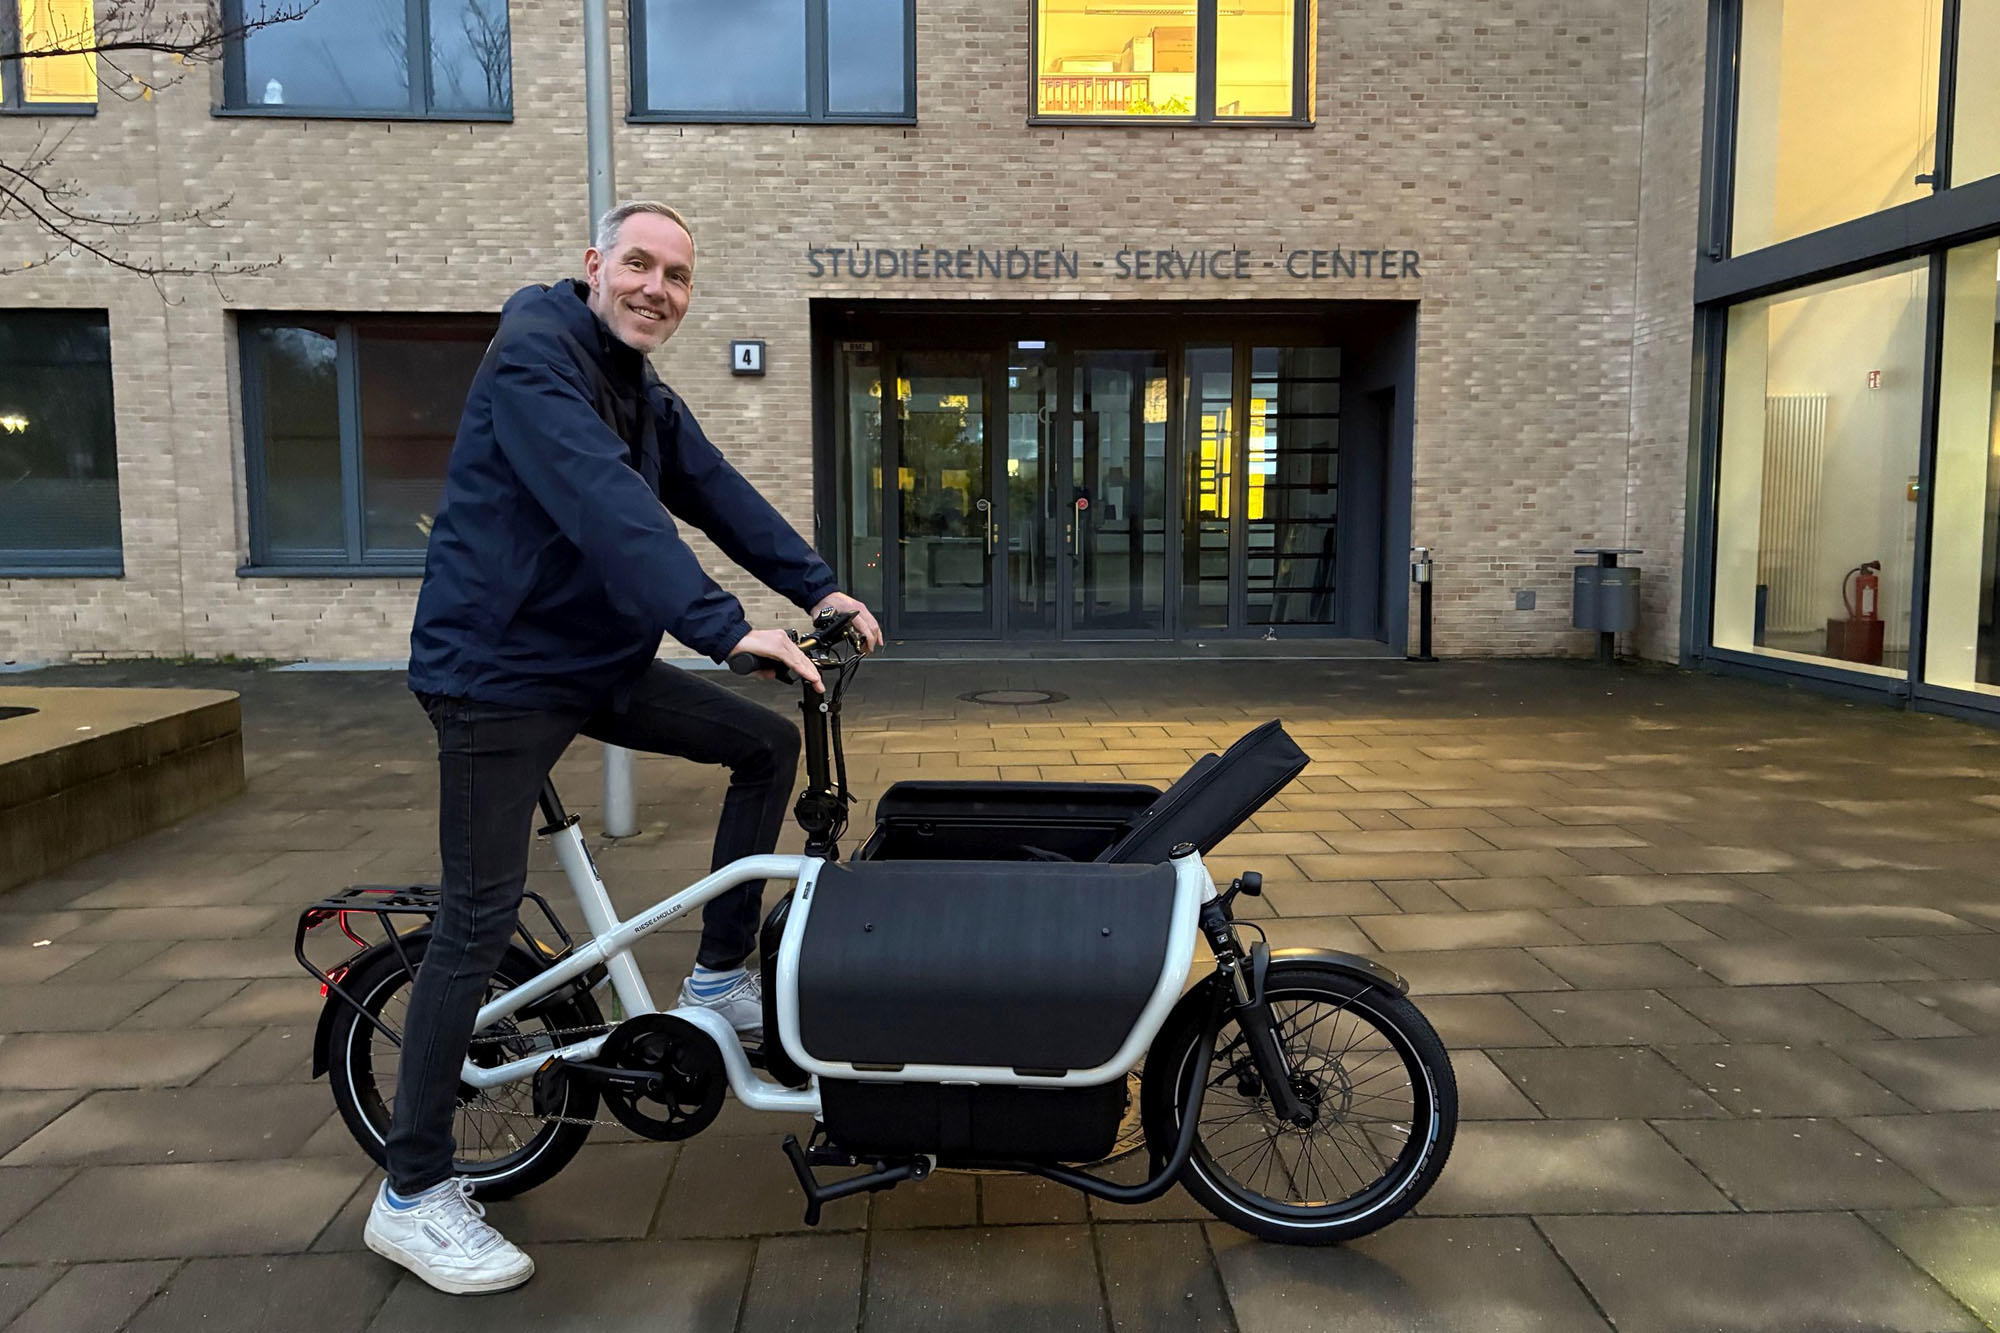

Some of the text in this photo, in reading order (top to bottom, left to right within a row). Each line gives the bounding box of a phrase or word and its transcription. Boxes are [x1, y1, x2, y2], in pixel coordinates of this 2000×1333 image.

[808, 249, 1078, 279] STUDIERENDEN
[1115, 249, 1250, 279] SERVICE
[1286, 249, 1422, 279] CENTER
[742, 349, 752, 366] 4
